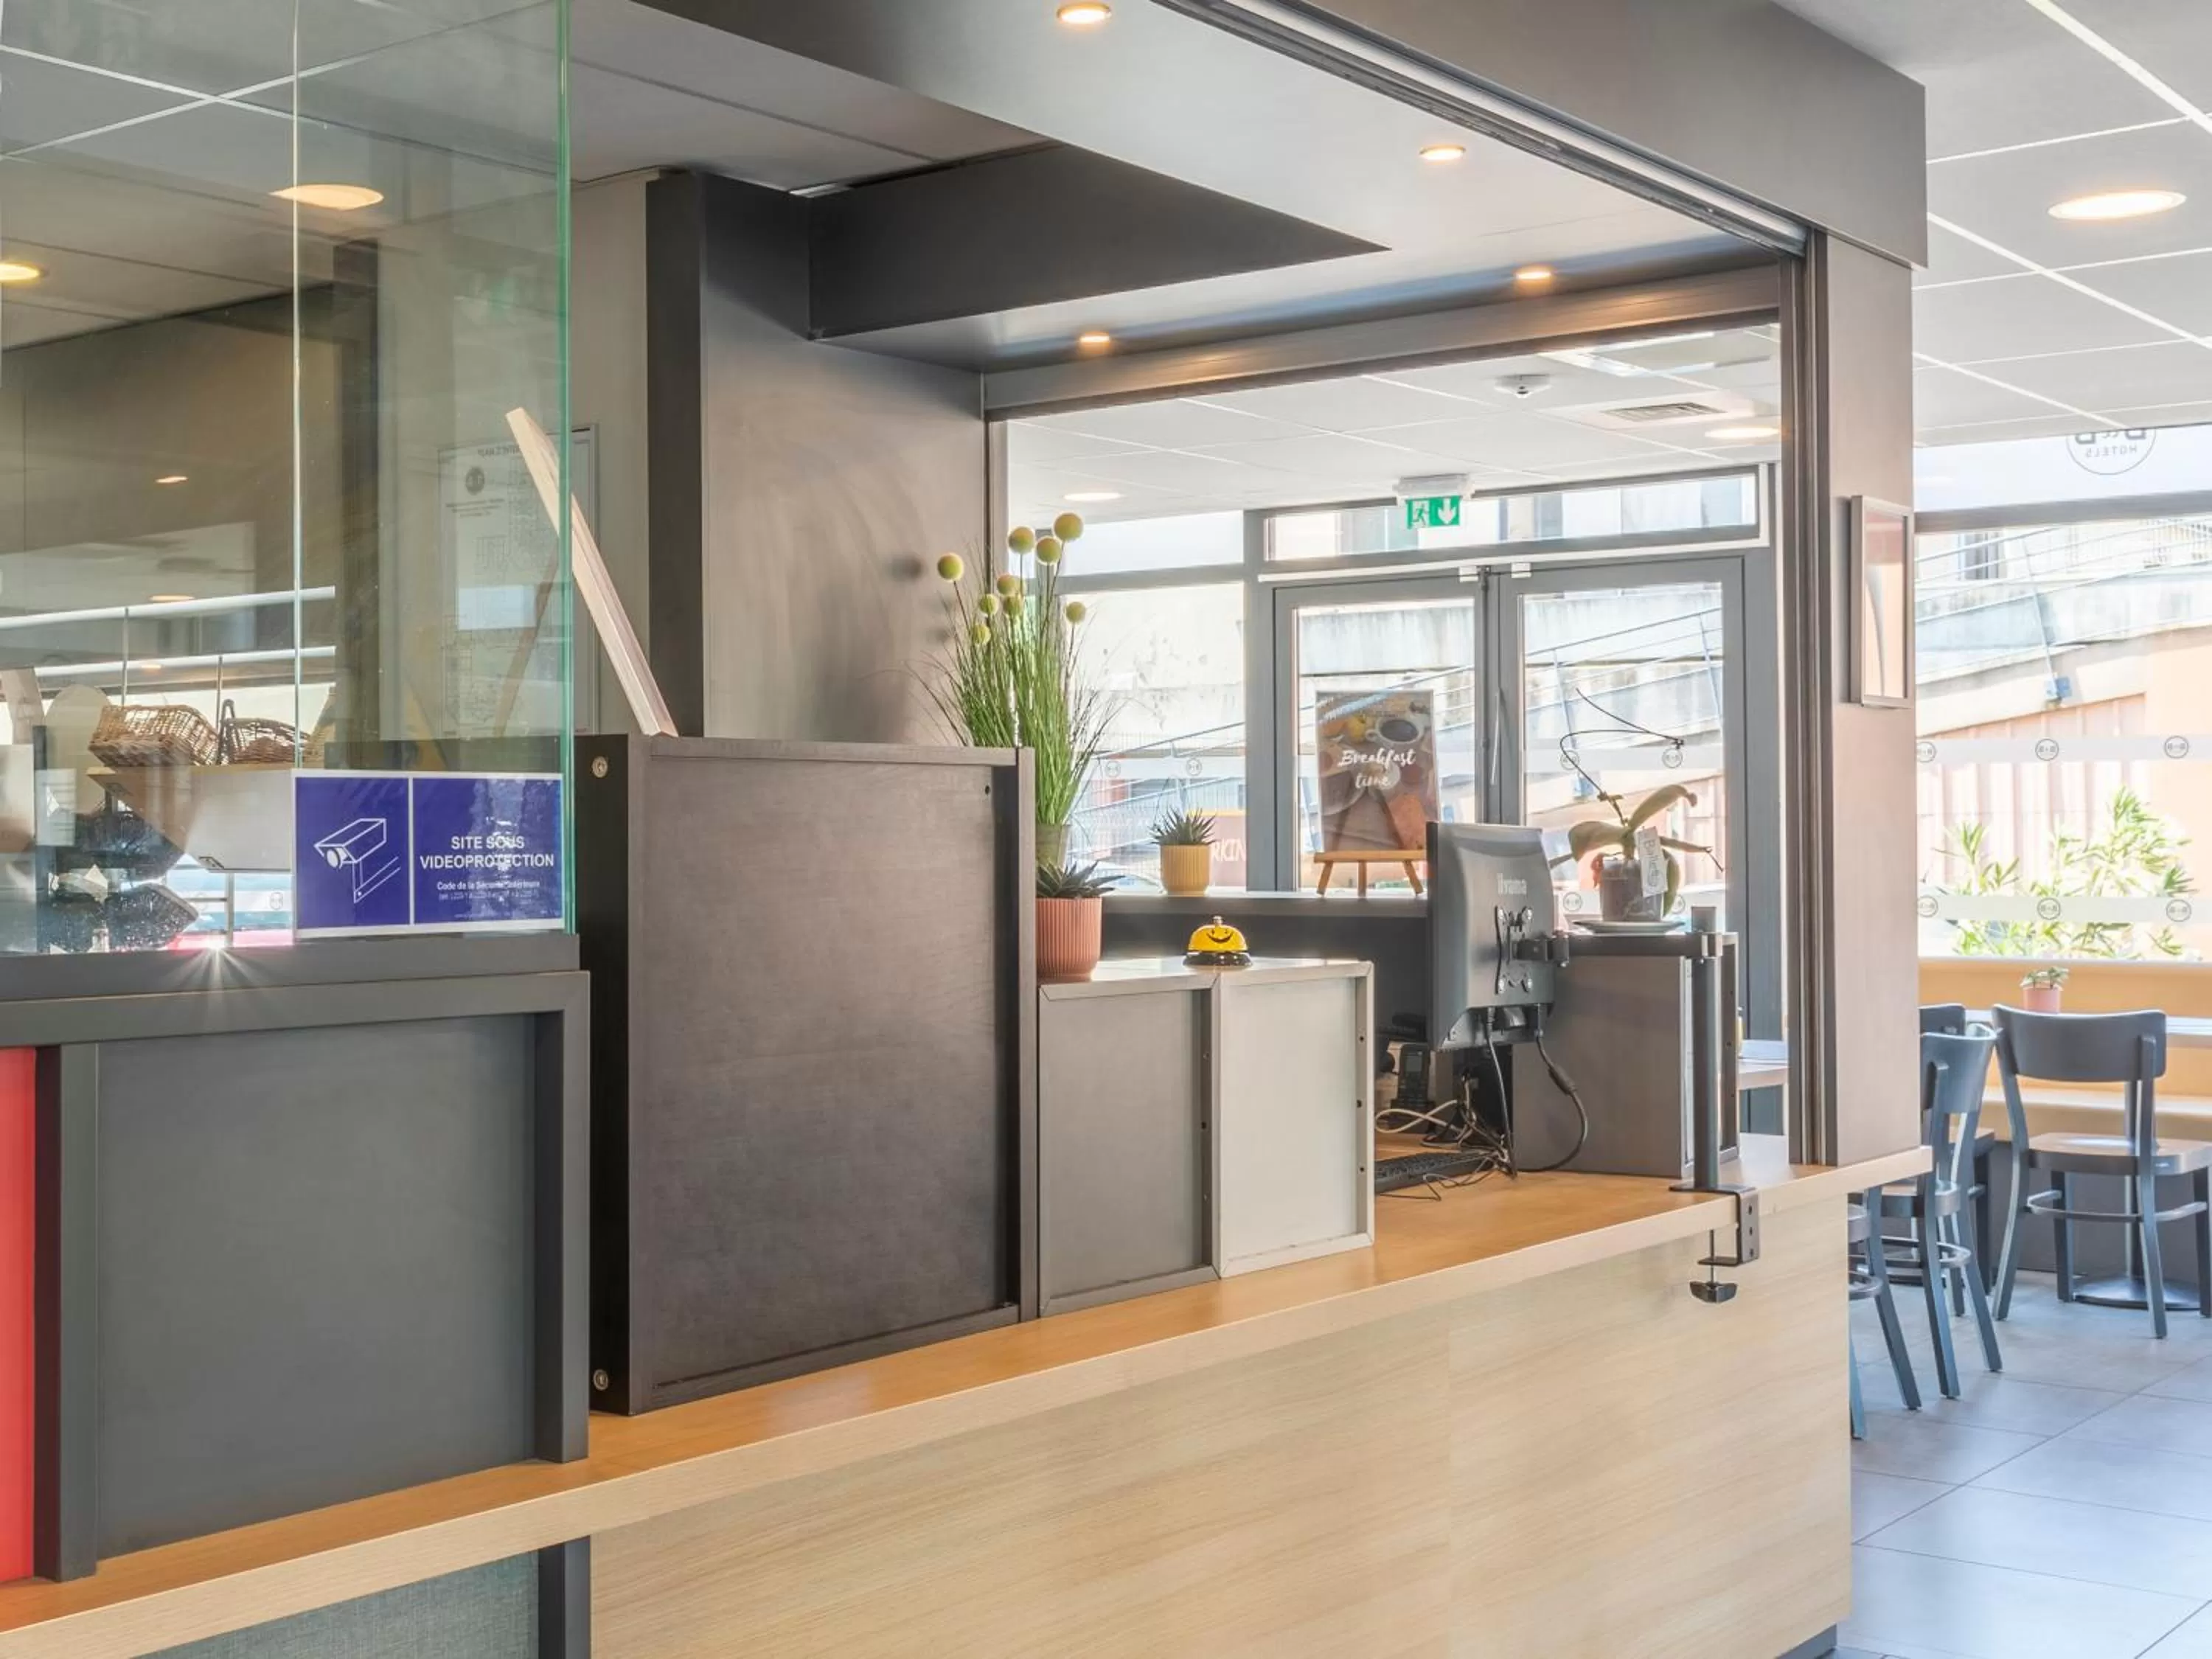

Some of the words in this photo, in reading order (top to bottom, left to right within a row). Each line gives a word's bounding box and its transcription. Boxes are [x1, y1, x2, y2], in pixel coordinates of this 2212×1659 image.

[1338, 748, 1416, 768] Breakfast
[1355, 772, 1391, 789] time
[451, 835, 483, 849] SITE
[486, 835, 525, 849] SOUS
[1210, 838, 1246, 862] RKIN
[420, 853, 554, 870] VIDEOPROTECTION
[437, 880, 456, 891] Code
[457, 880, 467, 890] de
